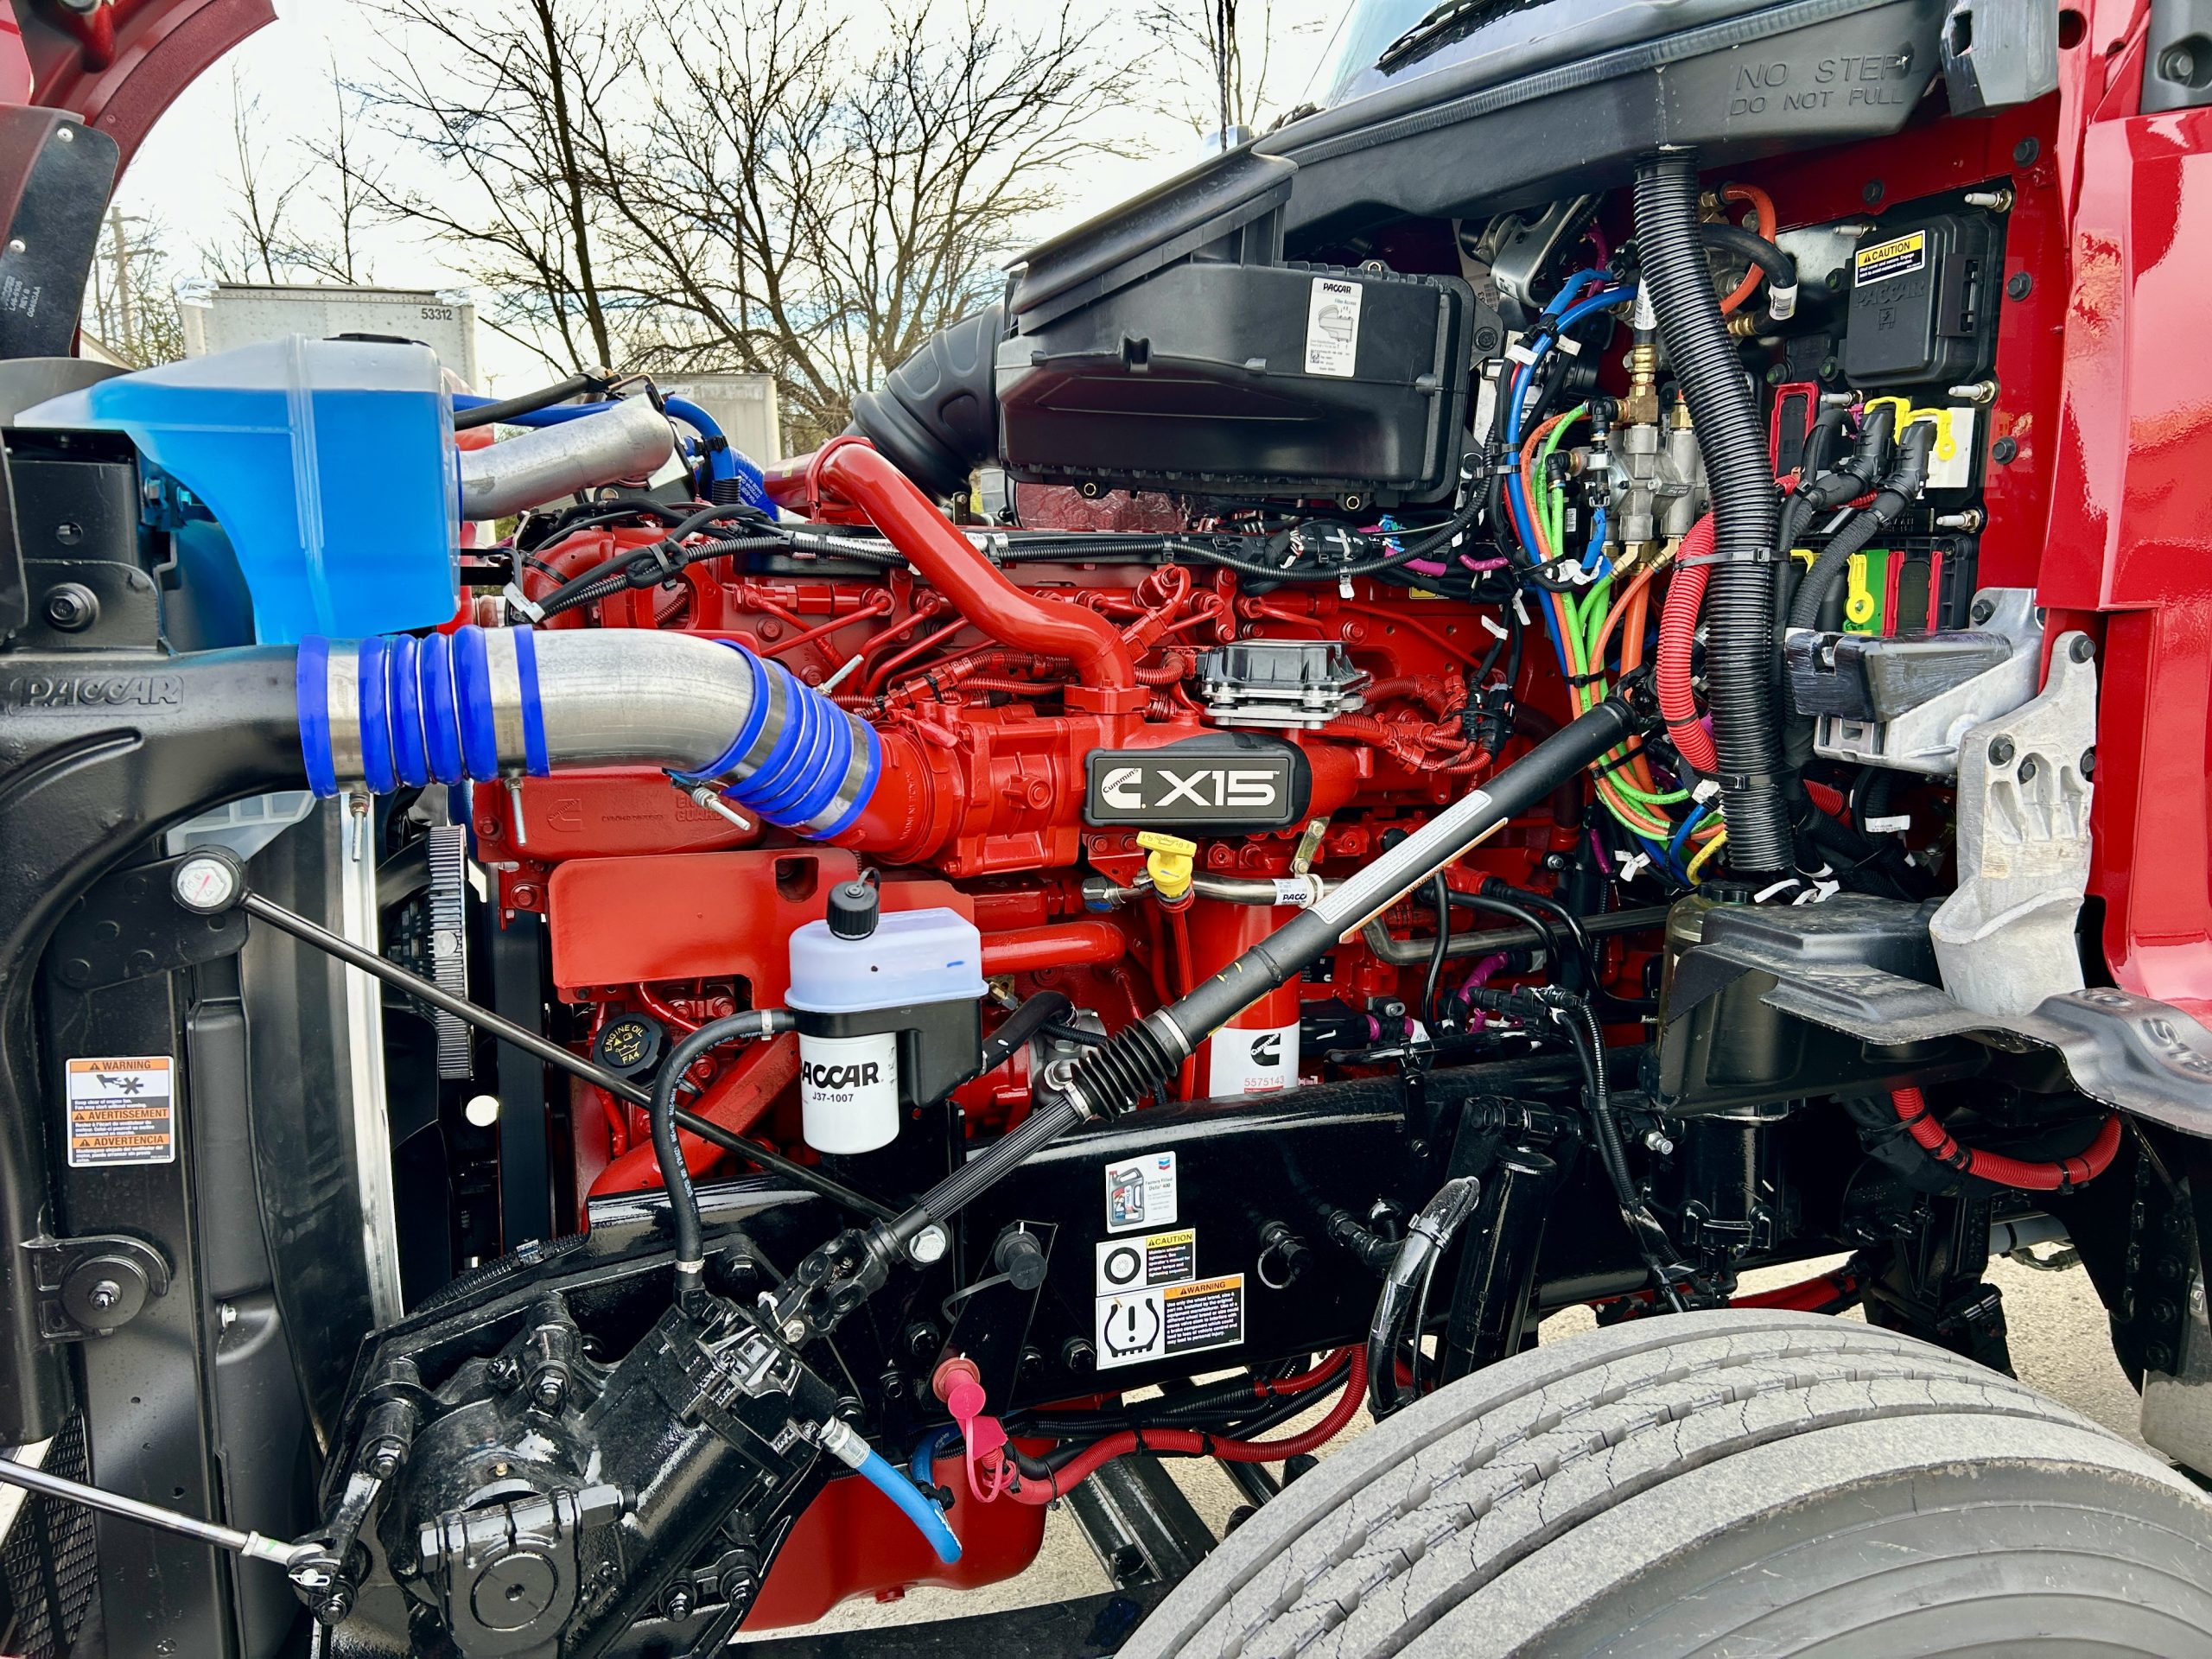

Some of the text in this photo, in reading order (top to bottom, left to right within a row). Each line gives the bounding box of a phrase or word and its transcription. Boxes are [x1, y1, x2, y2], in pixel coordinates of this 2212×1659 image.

[1735, 54, 1904, 90] NO STEP
[1730, 87, 1904, 116] DO NOT PULL
[1872, 241, 1910, 260] CAUTION
[1323, 283, 1351, 294] PACCAR
[1853, 281, 1925, 308] PACCAR
[422, 308, 453, 320] 53312
[20, 677, 178, 708] PACCAR
[1102, 767, 1140, 793] Cummins
[1154, 770, 1276, 807] X15
[676, 809, 724, 822] GUARD
[605, 1024, 644, 1052] ENGINE OIL
[622, 1052, 639, 1064] FA4
[103, 1061, 151, 1070] WARNING
[801, 1060, 880, 1090] ACCAR
[1244, 1076, 1285, 1087] 5575143
[812, 1092, 854, 1102] J37-1007
[89, 1109, 167, 1120] AVERTISSEMENT
[94, 1135, 163, 1147] ADVERTENCIA
[1155, 1234, 1192, 1245] CAUTION
[1186, 1281, 1225, 1294] WARNING
